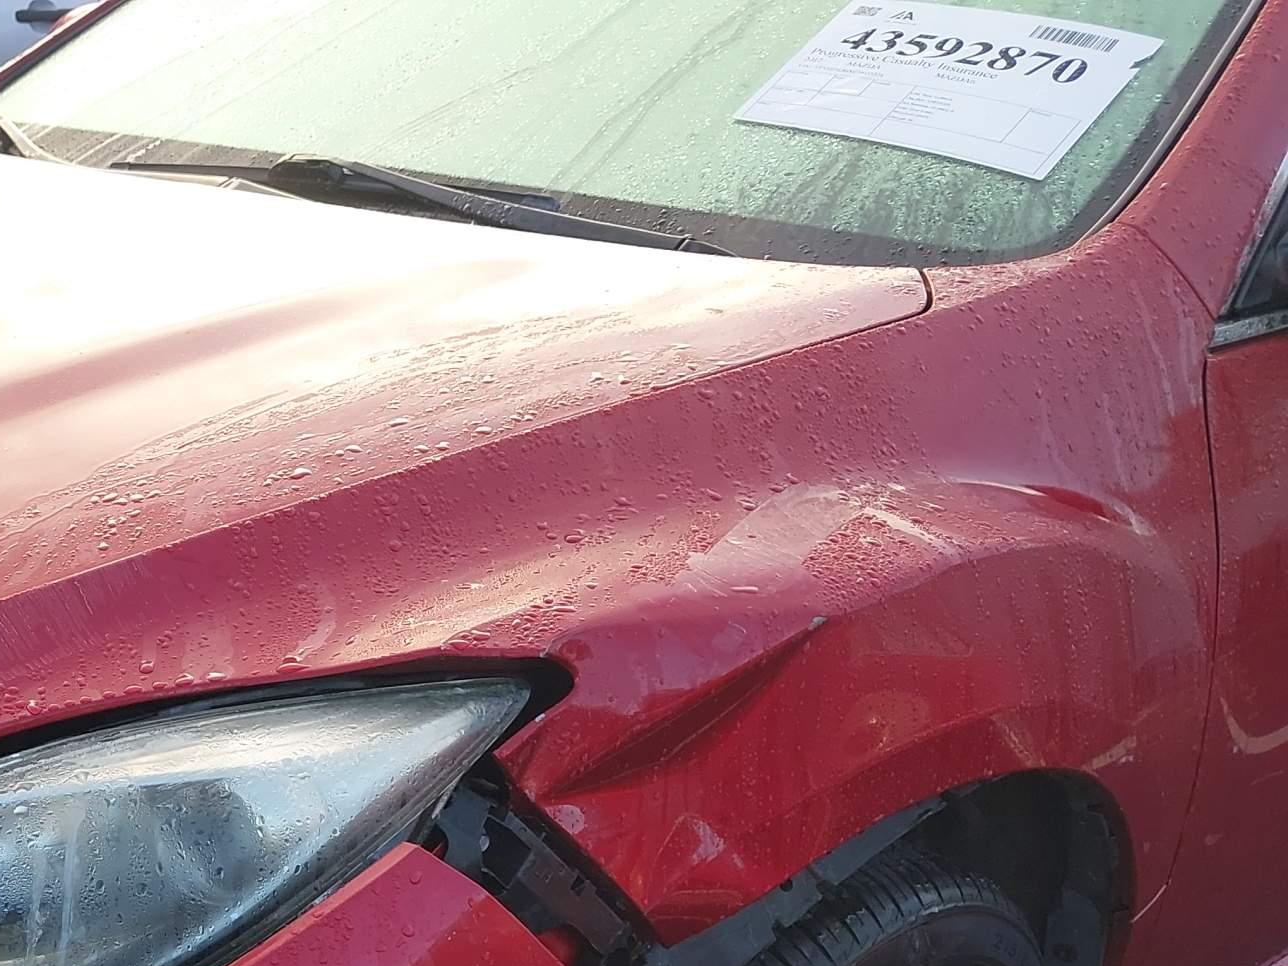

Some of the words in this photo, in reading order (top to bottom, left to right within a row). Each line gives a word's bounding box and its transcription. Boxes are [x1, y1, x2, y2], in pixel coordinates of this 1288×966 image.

[810, 47, 881, 63] Progressive
[881, 54, 935, 69] Casualty
[937, 62, 999, 80] Insurance
[840, 28, 1088, 84] 43592870
